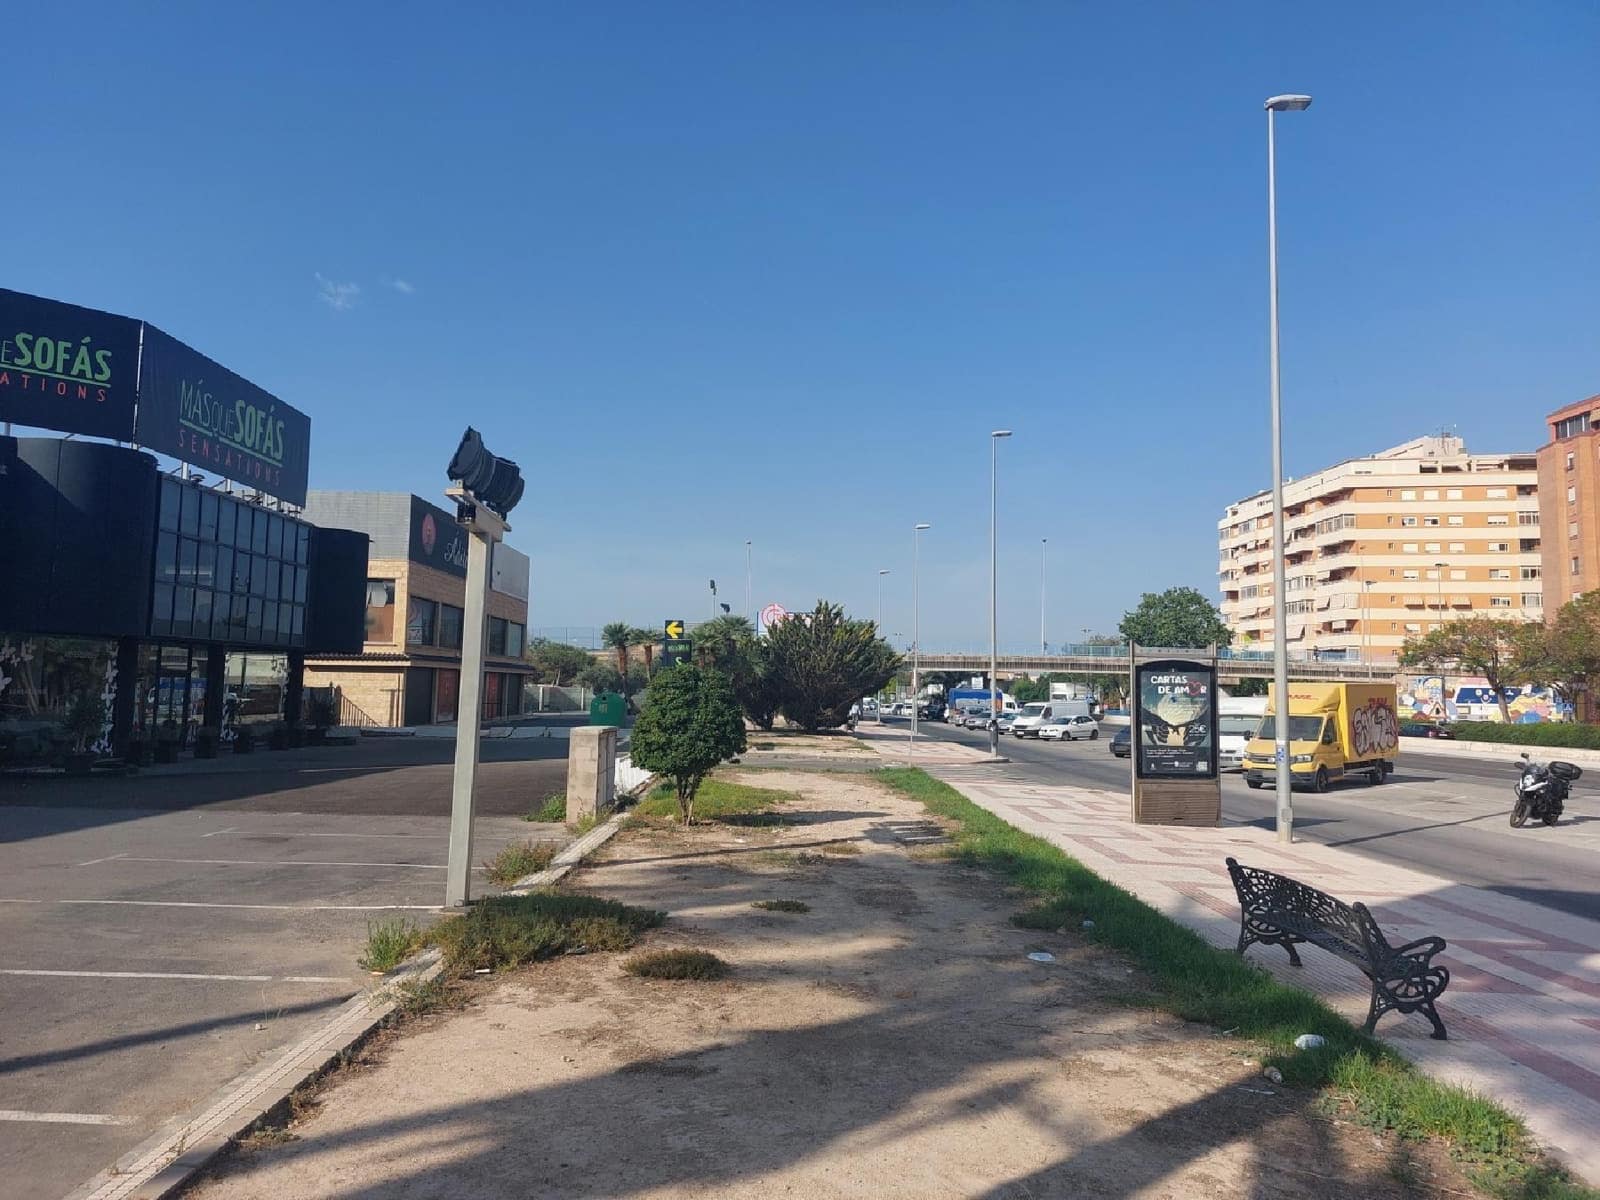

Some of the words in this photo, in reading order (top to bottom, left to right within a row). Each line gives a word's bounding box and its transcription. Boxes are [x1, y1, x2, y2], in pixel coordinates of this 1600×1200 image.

[177, 428, 281, 488] SENSATIONS
[1150, 675, 1188, 684] CARTAS
[1157, 686, 1172, 695] DE
